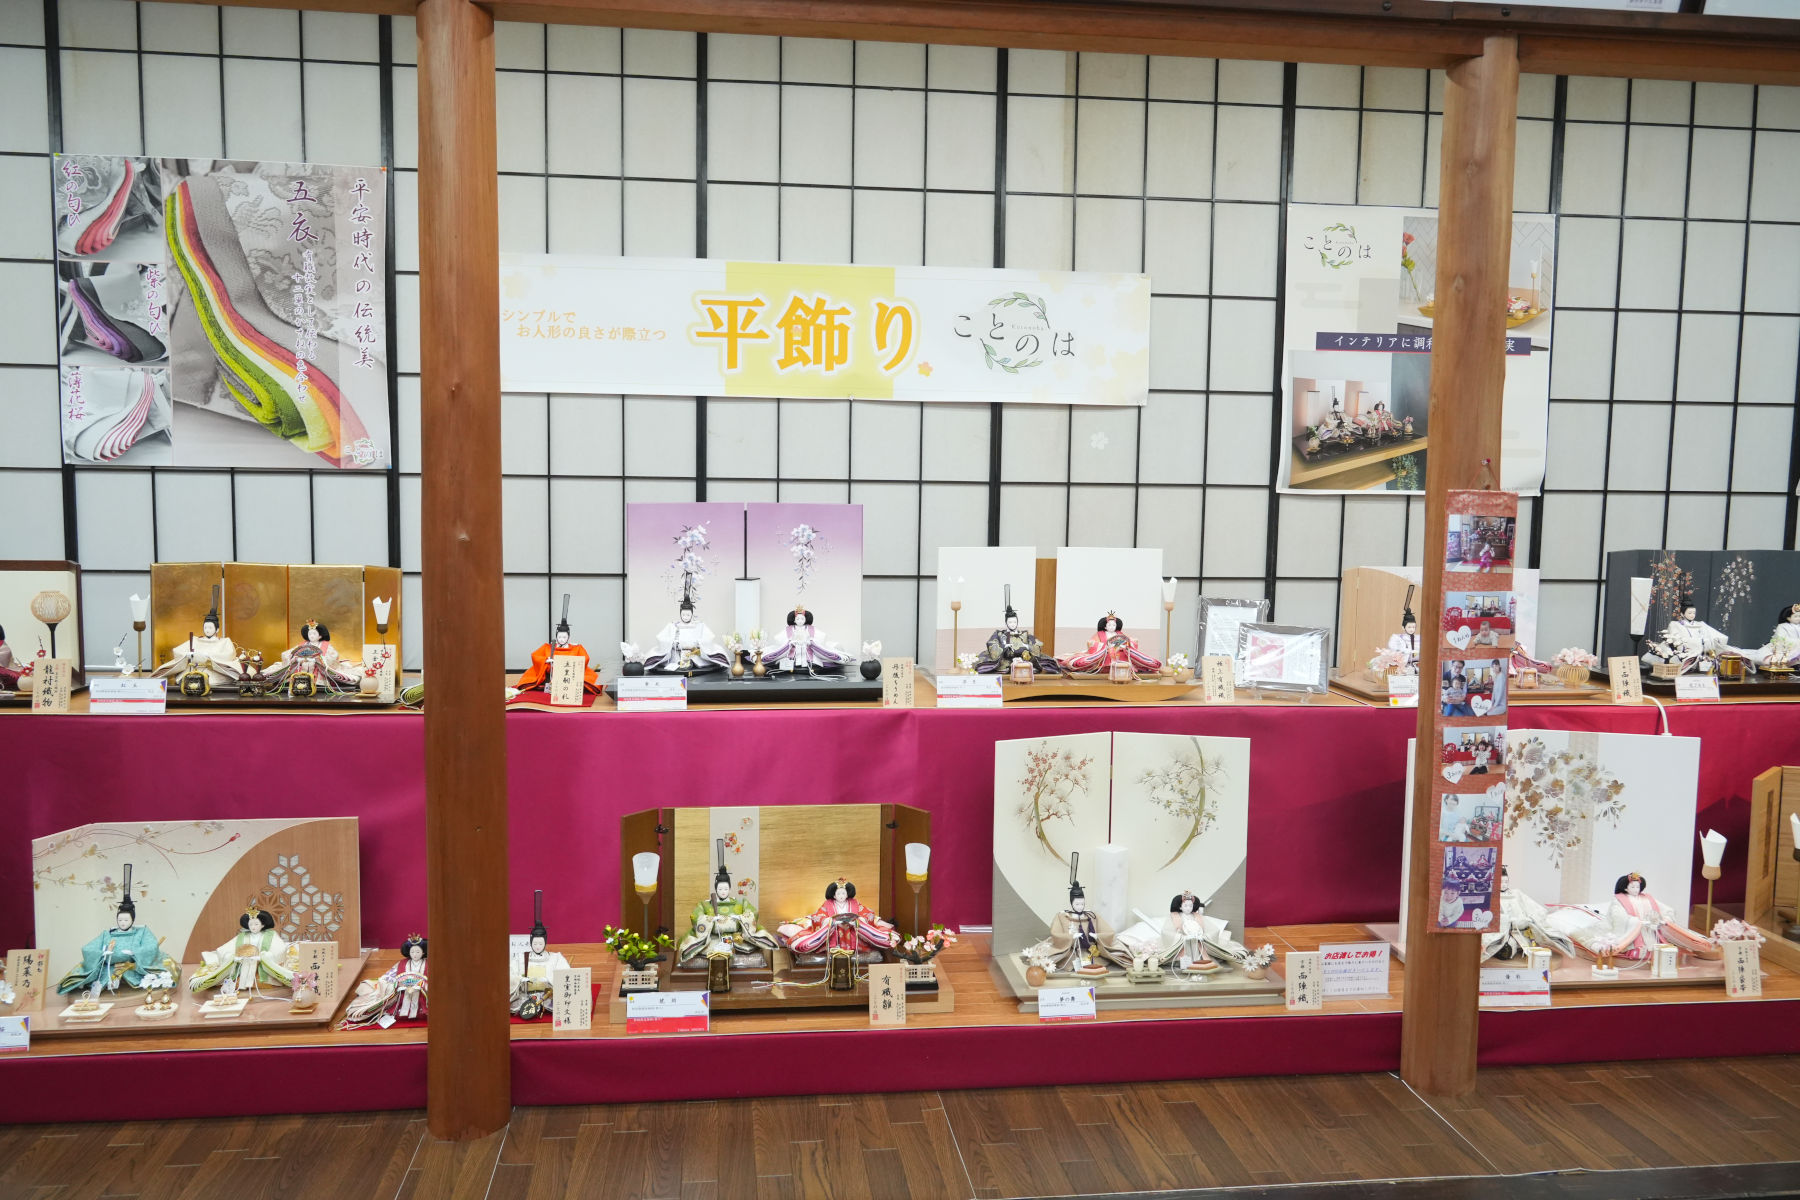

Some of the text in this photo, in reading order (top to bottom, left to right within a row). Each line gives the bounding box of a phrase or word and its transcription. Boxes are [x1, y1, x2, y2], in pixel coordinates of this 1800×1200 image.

[287, 181, 318, 242] 五衣
[1303, 235, 1372, 259] ことのは
[350, 178, 376, 369] 平安時代の伝統美
[145, 268, 162, 336] 紫の匂ひ
[502, 309, 576, 325] シンプルで
[517, 325, 667, 342] お人形の良さが際立つ
[694, 294, 914, 372] 平飾り
[953, 312, 1076, 357] ことのは
[891, 663, 900, 705] 丹後ちりめん
